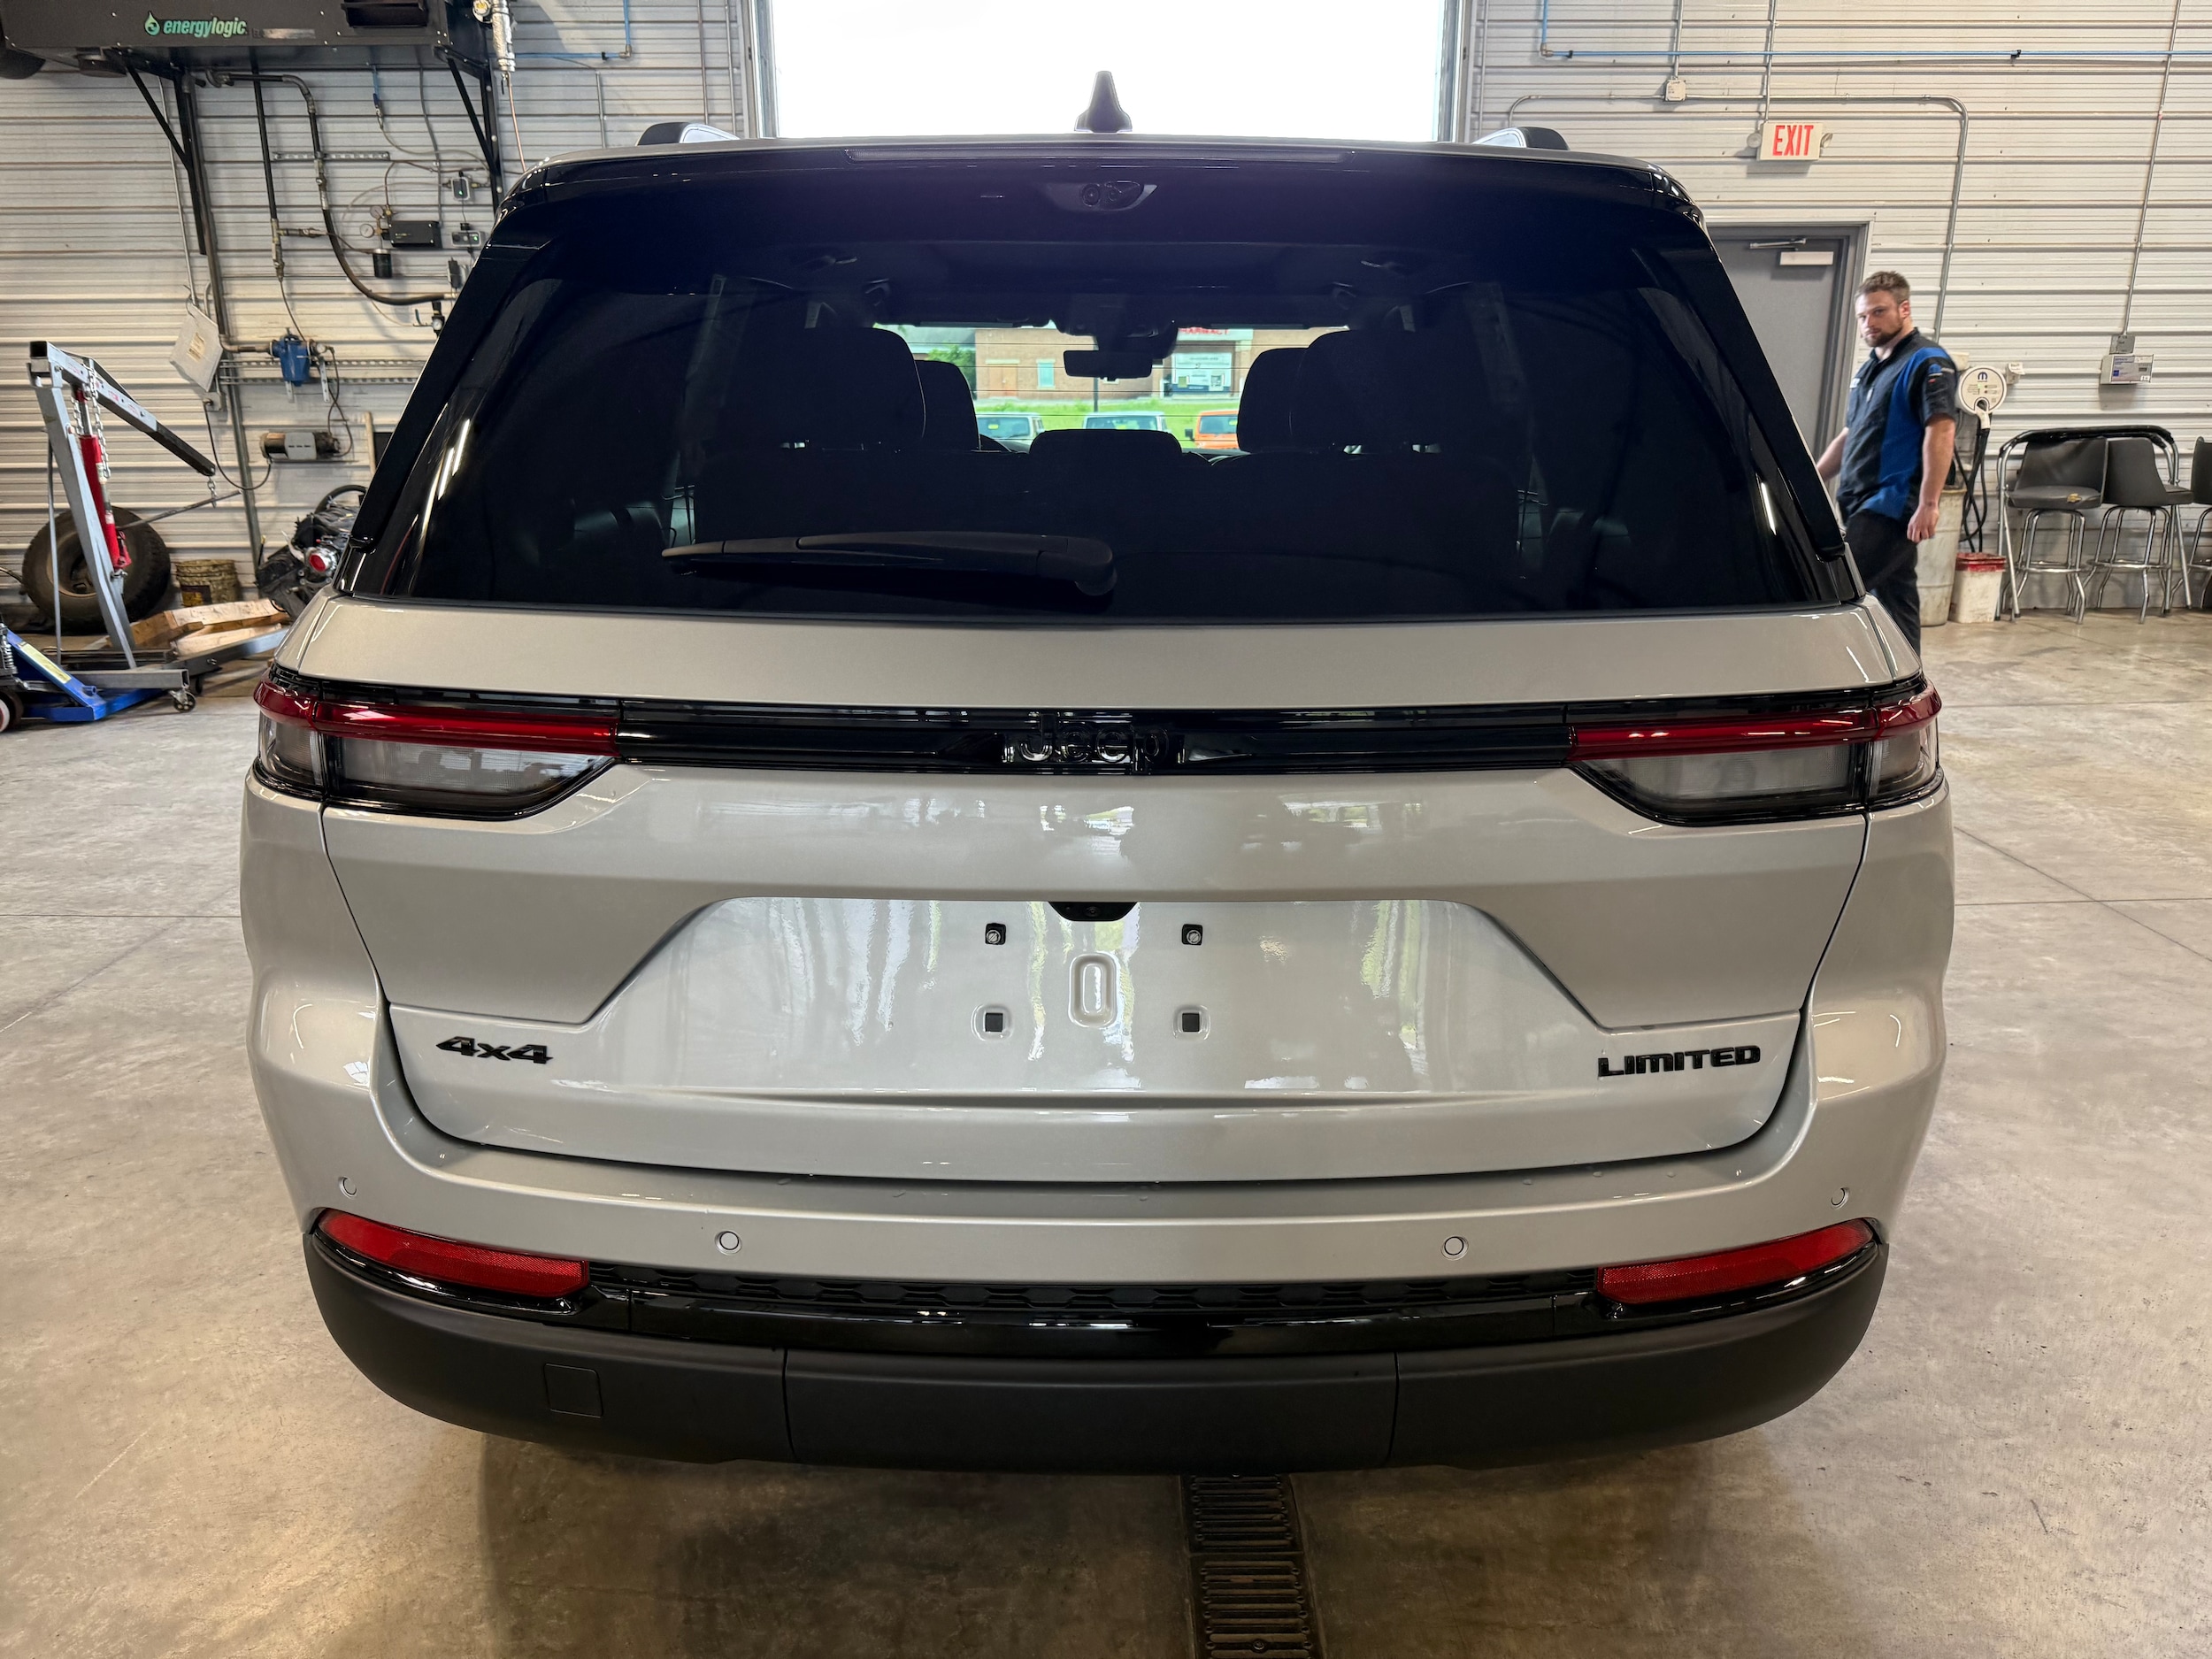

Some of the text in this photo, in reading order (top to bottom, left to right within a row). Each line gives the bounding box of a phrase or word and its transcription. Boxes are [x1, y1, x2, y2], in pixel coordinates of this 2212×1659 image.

[163, 17, 248, 38] energylogic
[1772, 125, 1815, 157] EXIT
[1018, 711, 1170, 772] Jeep
[435, 1035, 554, 1064] 4x4
[1598, 1045, 1761, 1077] LIMITED
